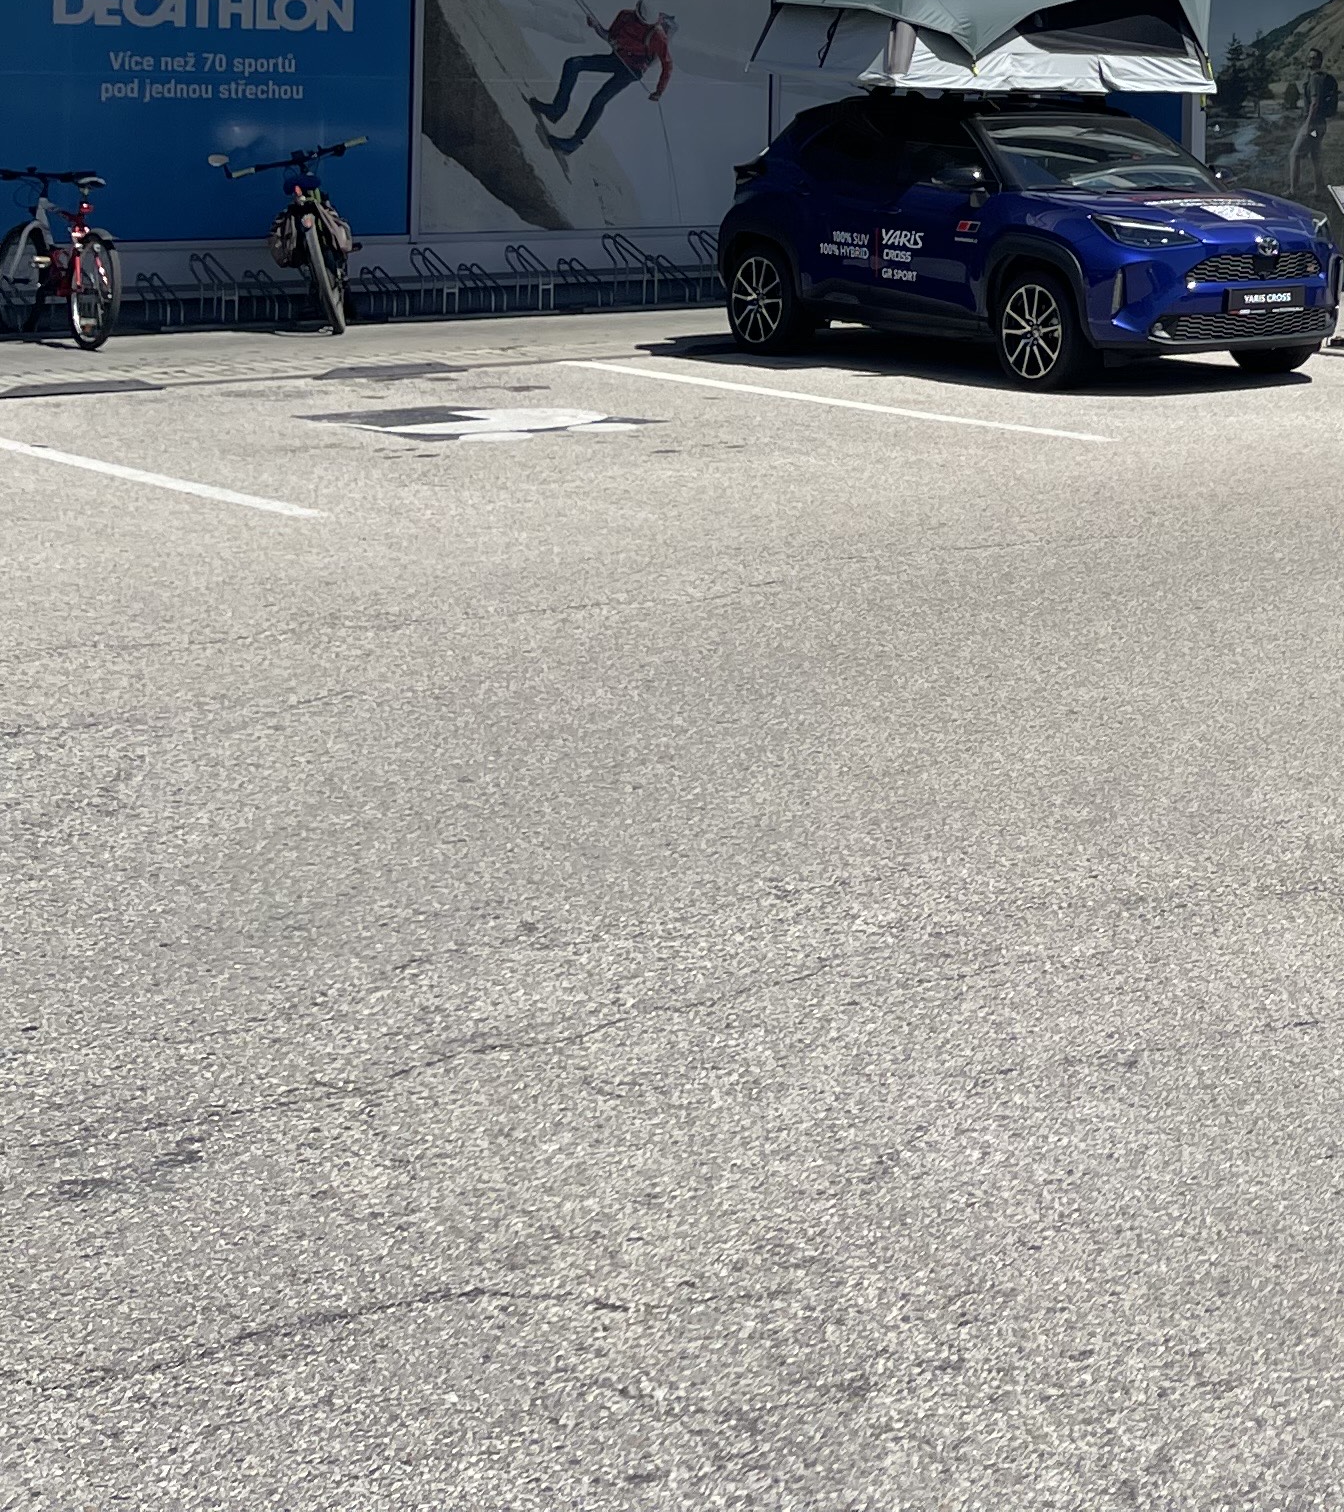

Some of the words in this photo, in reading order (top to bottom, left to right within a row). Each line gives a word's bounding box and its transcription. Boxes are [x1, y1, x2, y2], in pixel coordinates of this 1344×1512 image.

[109, 50, 154, 72] Více
[160, 52, 196, 73] než
[202, 53, 227, 72] 70
[233, 53, 296, 77] sportů
[100, 79, 139, 102] pod
[144, 79, 212, 103] jednou
[219, 80, 304, 100] střechou
[833, 230, 852, 244] 100%
[853, 232, 870, 246] SUV
[820, 242, 839, 256] 100%
[840, 245, 869, 259] HYBRID
[883, 249, 912, 263] CROSS
[881, 268, 893, 280] GR
[893, 268, 918, 282] SPORT
[1243, 294, 1265, 304] YARIS
[1267, 292, 1292, 303] CROSS
